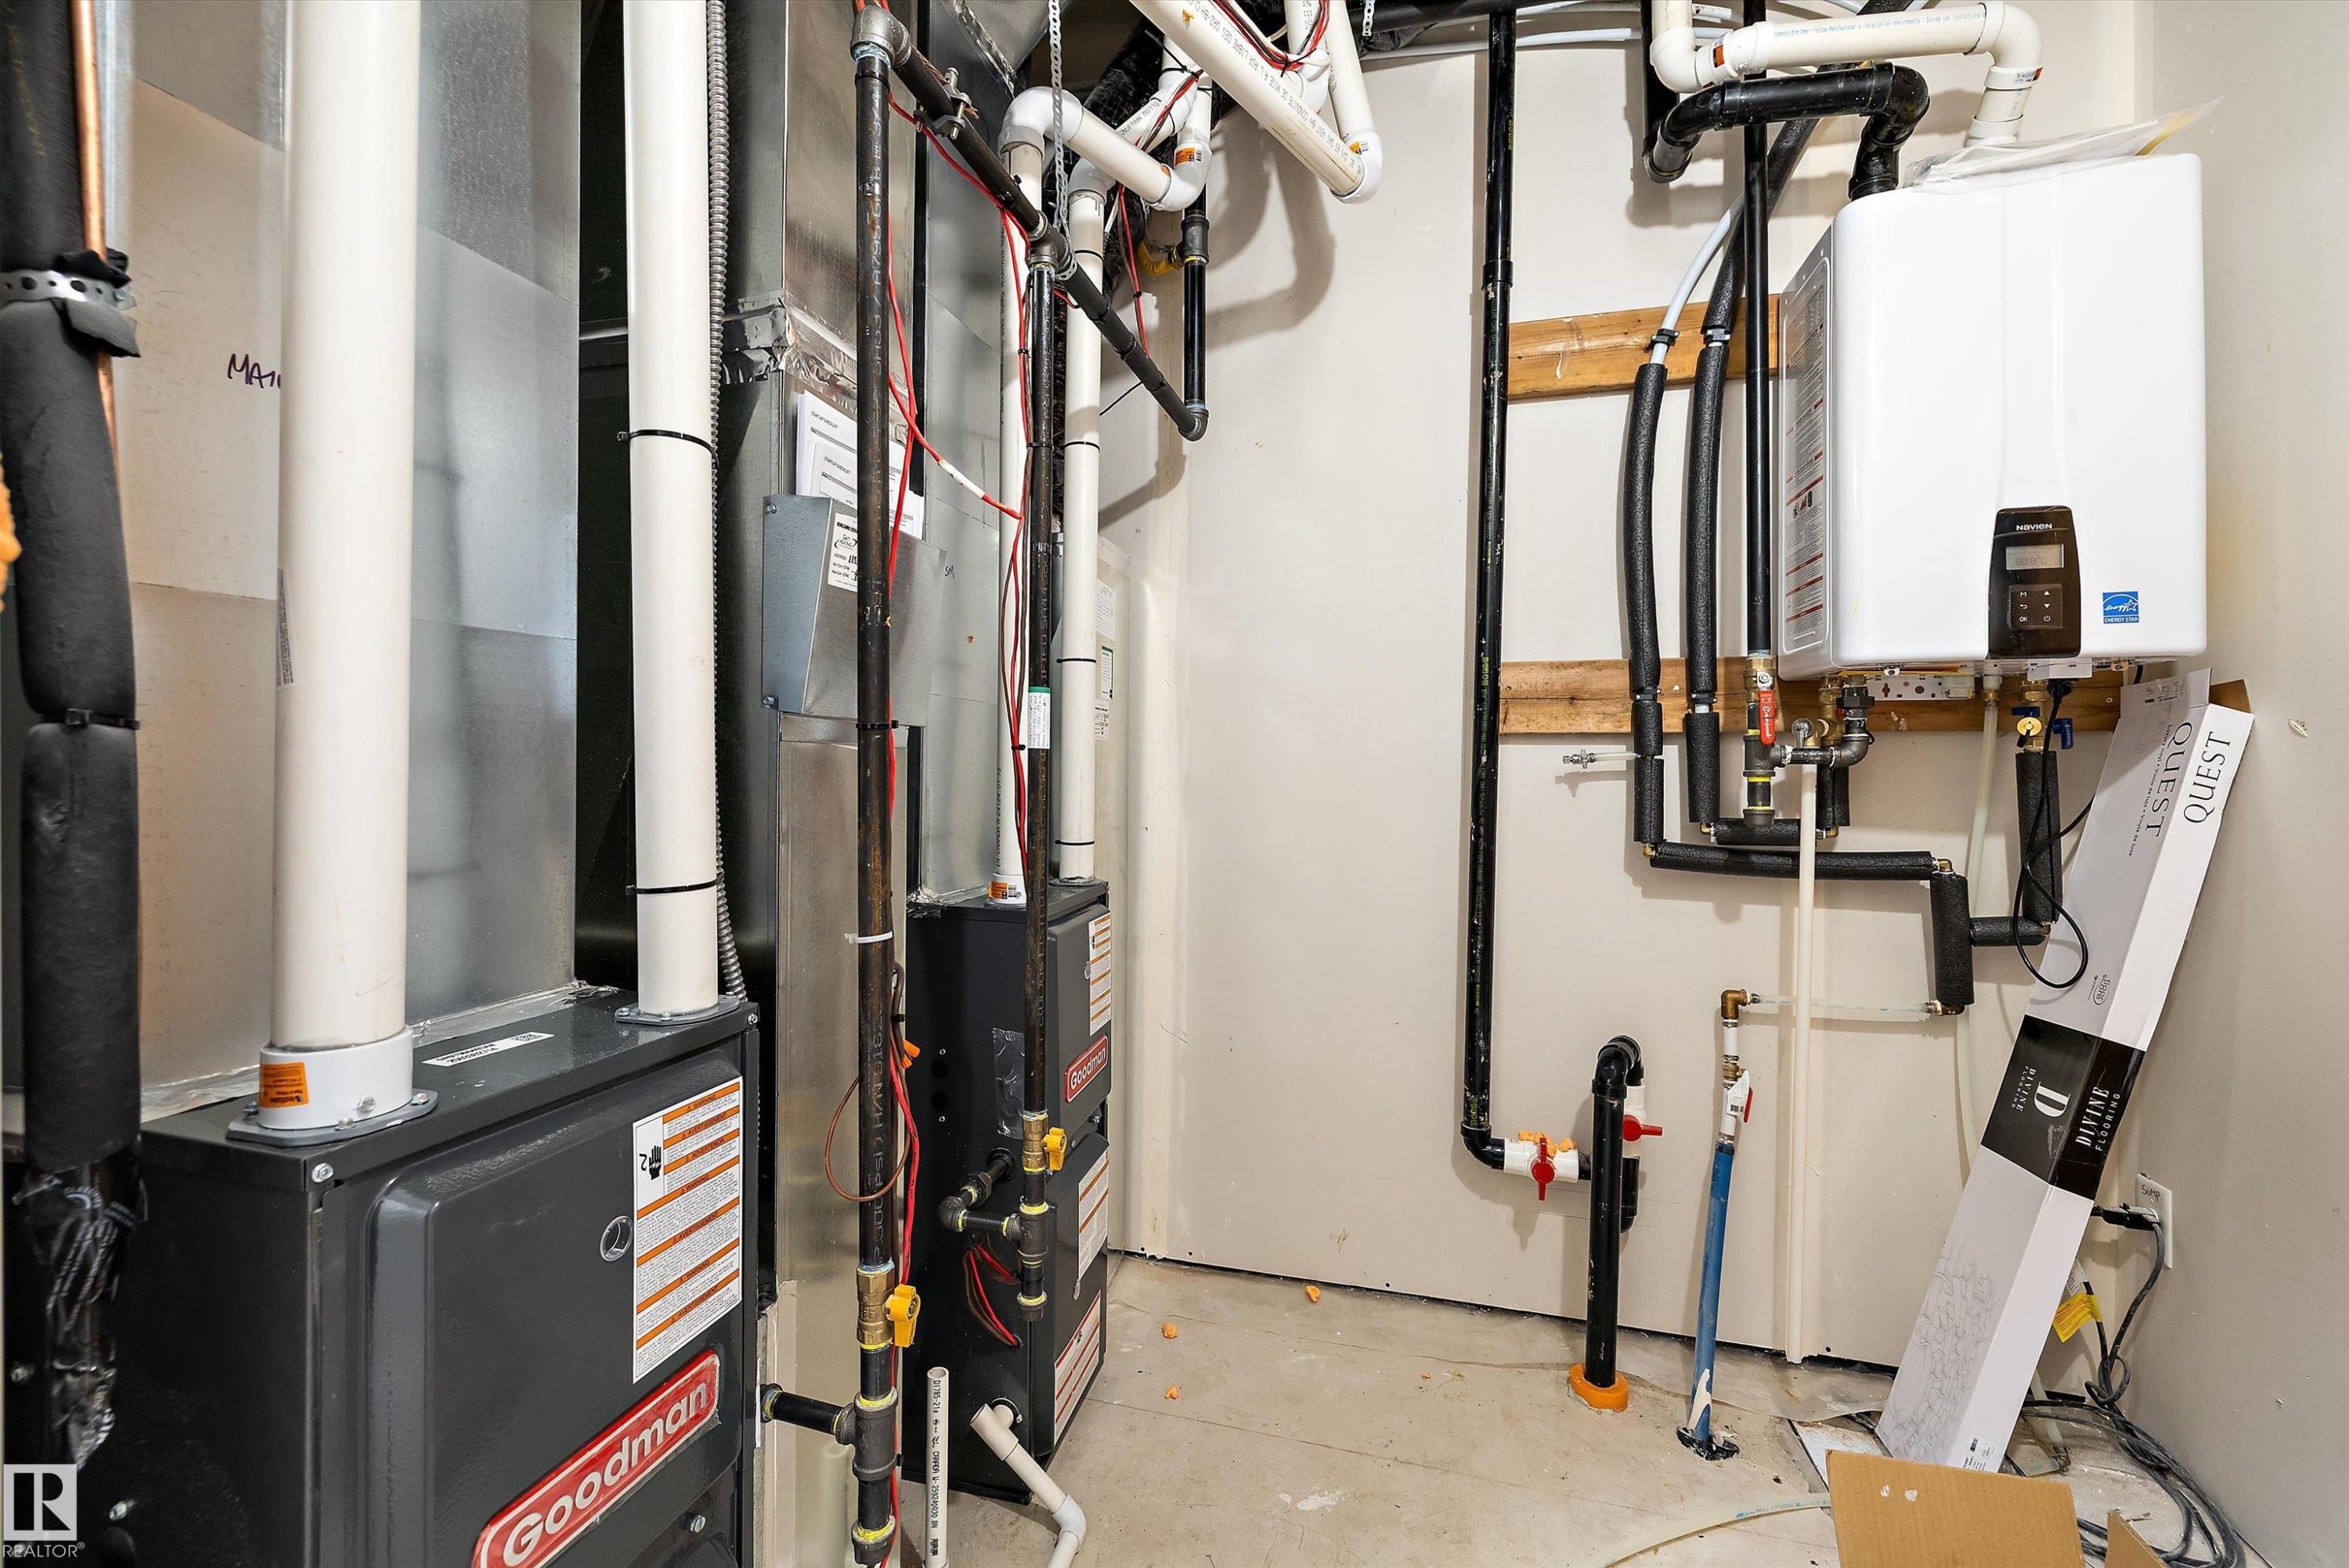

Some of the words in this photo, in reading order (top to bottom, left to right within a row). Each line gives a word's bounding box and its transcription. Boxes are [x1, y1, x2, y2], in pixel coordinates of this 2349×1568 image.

[2161, 723, 2172, 746] Luxury
[2145, 721, 2192, 837] QUEST
[2183, 731, 2231, 824] QUEST
[1070, 1046, 1106, 1090] Goodman
[693, 1094, 716, 1108] WARNING
[2012, 1065, 2030, 1108] FLOORING
[2015, 1067, 2037, 1112] DIVINE
[2034, 1081, 2072, 1117] D
[688, 1112, 727, 1135] AVERTISSEMENT
[2076, 1086, 2110, 1147] DIVINE
[2095, 1093, 2120, 1152] FLOORING
[691, 1137, 725, 1159] ADVERTENCIA
[685, 1175, 710, 1193] WARNING
[678, 1211, 720, 1240] AVERTISSEMENT
[686, 1260, 710, 1279] WARNING
[678, 1285, 719, 1318] AVERTISSEMENT
[503, 1382, 707, 1566] Goodman
